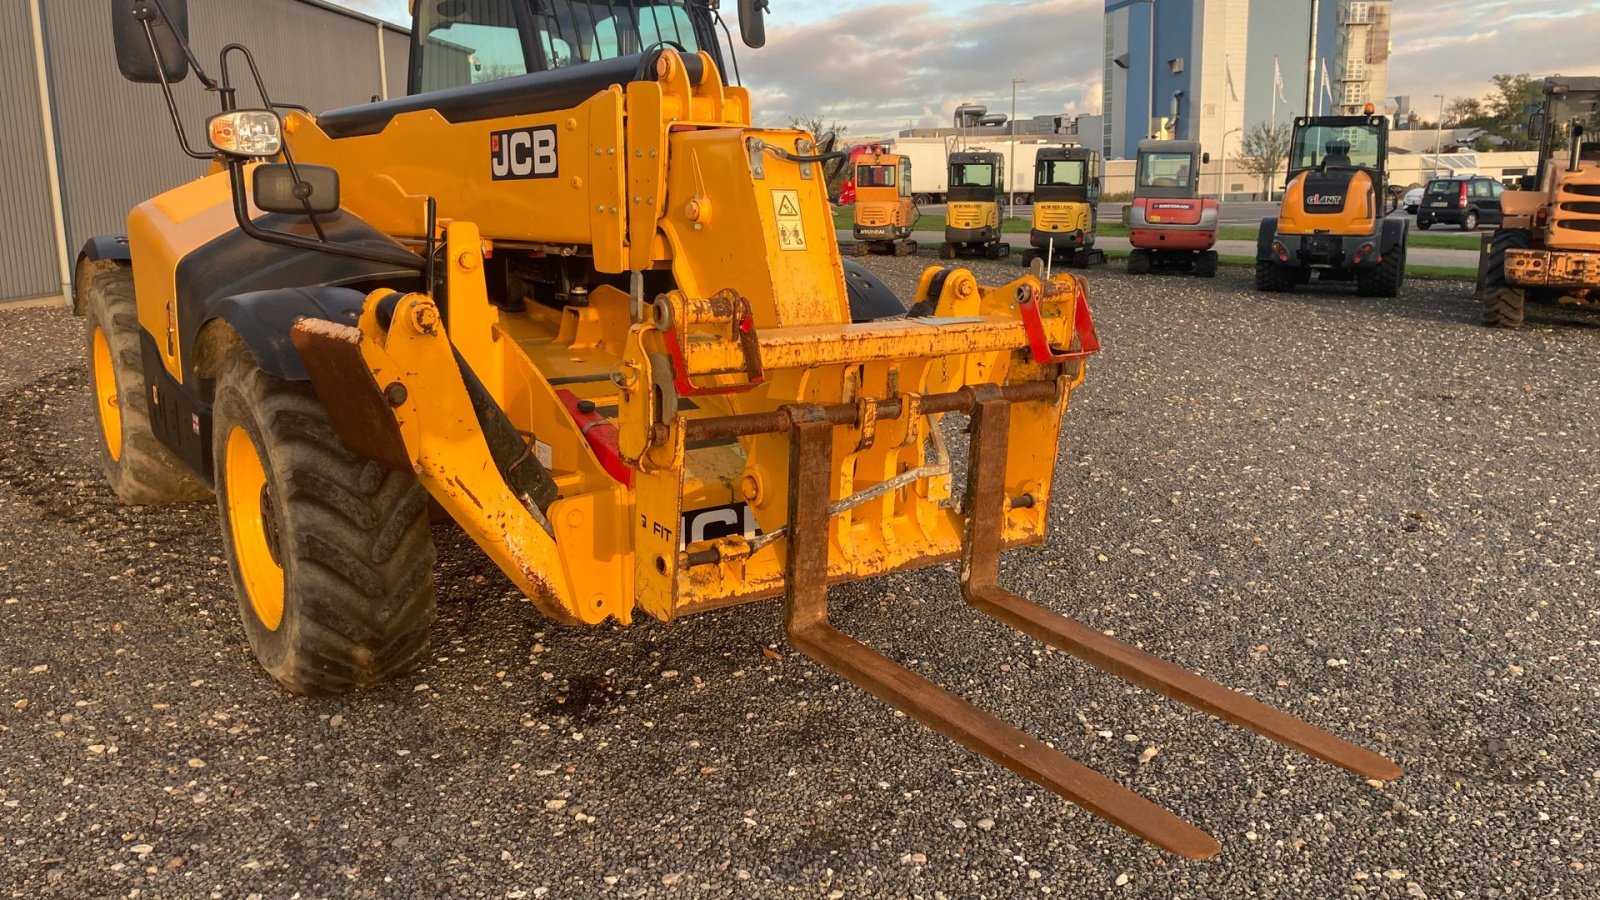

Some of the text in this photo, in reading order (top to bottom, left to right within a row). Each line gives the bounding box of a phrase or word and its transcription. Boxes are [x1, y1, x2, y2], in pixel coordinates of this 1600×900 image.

[492, 129, 557, 176] JCB
[1306, 193, 1342, 205] GIANT
[652, 520, 672, 543] FIT
